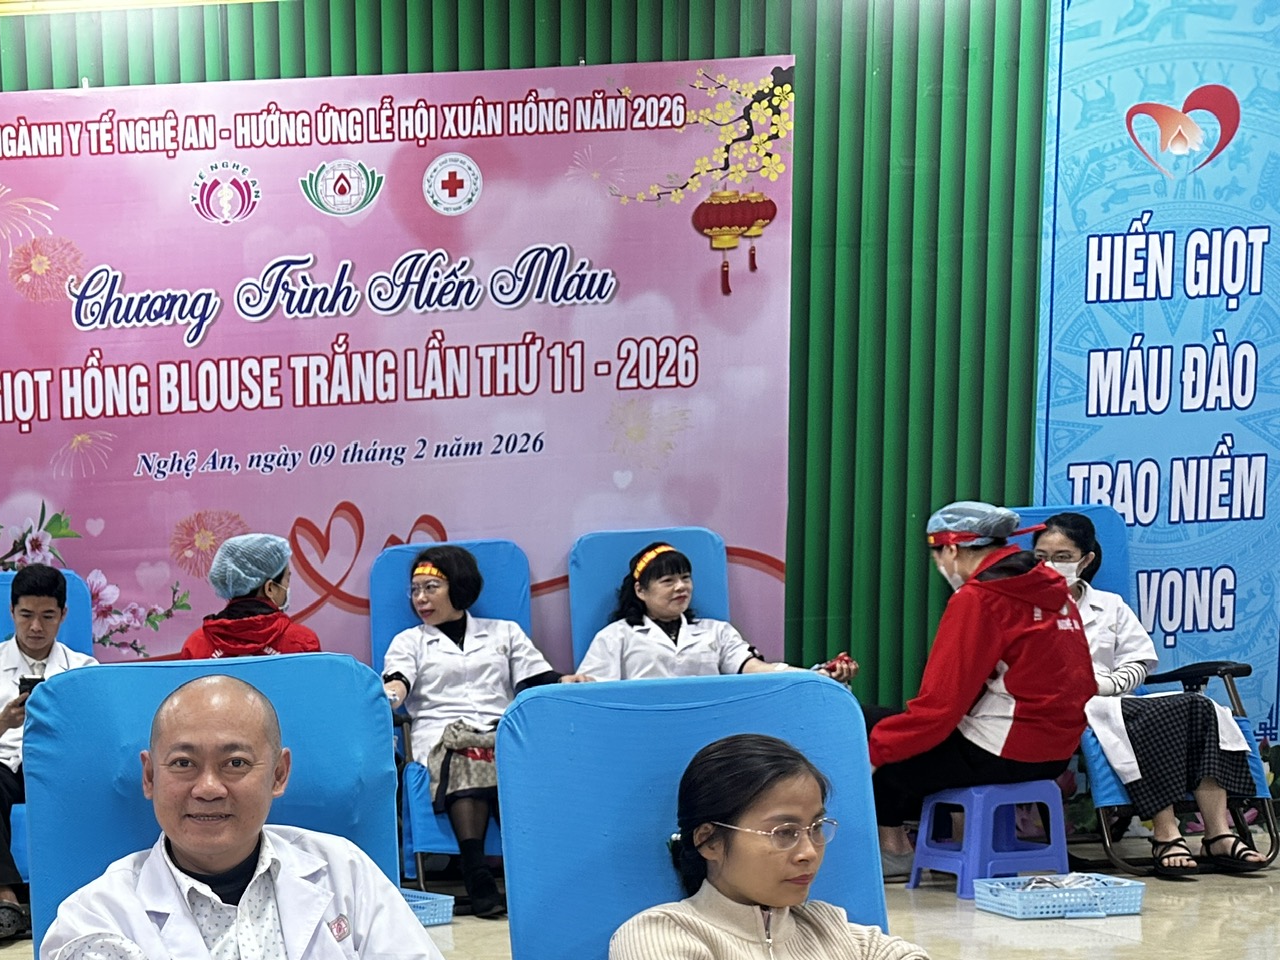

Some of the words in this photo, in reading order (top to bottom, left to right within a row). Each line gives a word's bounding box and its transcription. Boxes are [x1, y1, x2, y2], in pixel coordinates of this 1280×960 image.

[66, 122, 83, 155] Y
[86, 110, 115, 154] TẾ
[118, 111, 178, 158] NGHỆ
[182, 114, 215, 149] AN
[235, 102, 311, 148] HƯỞNG
[316, 103, 363, 145] ỨNG
[369, 98, 394, 142] LỄ
[399, 102, 437, 146] HỘI
[442, 96, 503, 138] XUÂN
[507, 91, 569, 135] HỒNG
[574, 92, 628, 131] NĂM
[632, 95, 686, 128] 2026
[237, 254, 357, 319] Trình
[369, 250, 481, 317] Hiến
[491, 244, 615, 307] Máu
[1086, 210, 1175, 302] HIẾN
[1185, 226, 1269, 310] GIỌT
[61, 349, 150, 419] HỒNG
[158, 356, 281, 414] BLOUSE
[289, 333, 397, 405] TRẮNG
[405, 331, 469, 399] LẦN
[476, 332, 543, 395] THỨ
[548, 341, 583, 393] 11
[595, 361, 611, 376] -
[617, 336, 698, 389] 2026
[1086, 334, 1172, 417] MÁU
[1181, 328, 1257, 412] ĐÀO
[136, 453, 196, 479] Nghệ
[200, 449, 239, 473] An,
[248, 446, 301, 472] ngày
[309, 444, 335, 466] 09
[342, 441, 407, 466] tháng
[414, 439, 428, 459] 2
[433, 437, 484, 458] năm
[491, 432, 545, 455] 2026
[1069, 458, 1160, 526] TRAO
[1169, 434, 1267, 523] NIỀM
[1136, 565, 1236, 647] VỌNG
